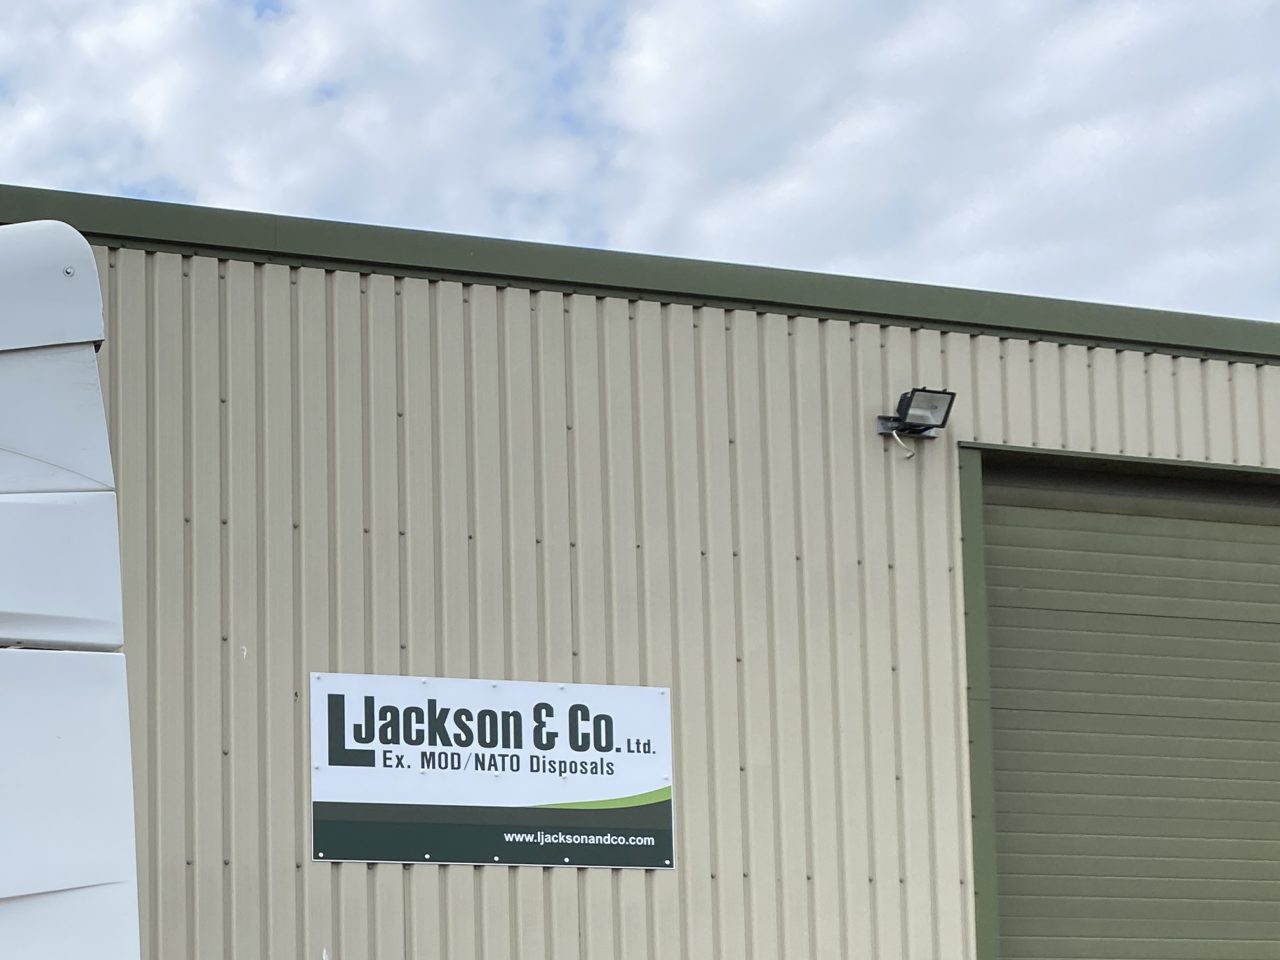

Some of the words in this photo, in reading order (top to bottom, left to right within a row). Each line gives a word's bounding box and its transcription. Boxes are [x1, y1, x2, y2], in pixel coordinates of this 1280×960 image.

[533, 702, 558, 751] &
[568, 703, 621, 753] Co.
[626, 738, 656, 755] Ltd.
[382, 750, 411, 769] Ex.
[420, 751, 521, 773] MOD/NATO
[530, 755, 615, 777] Disposals
[503, 831, 656, 846] www.ljacksonandco.com
